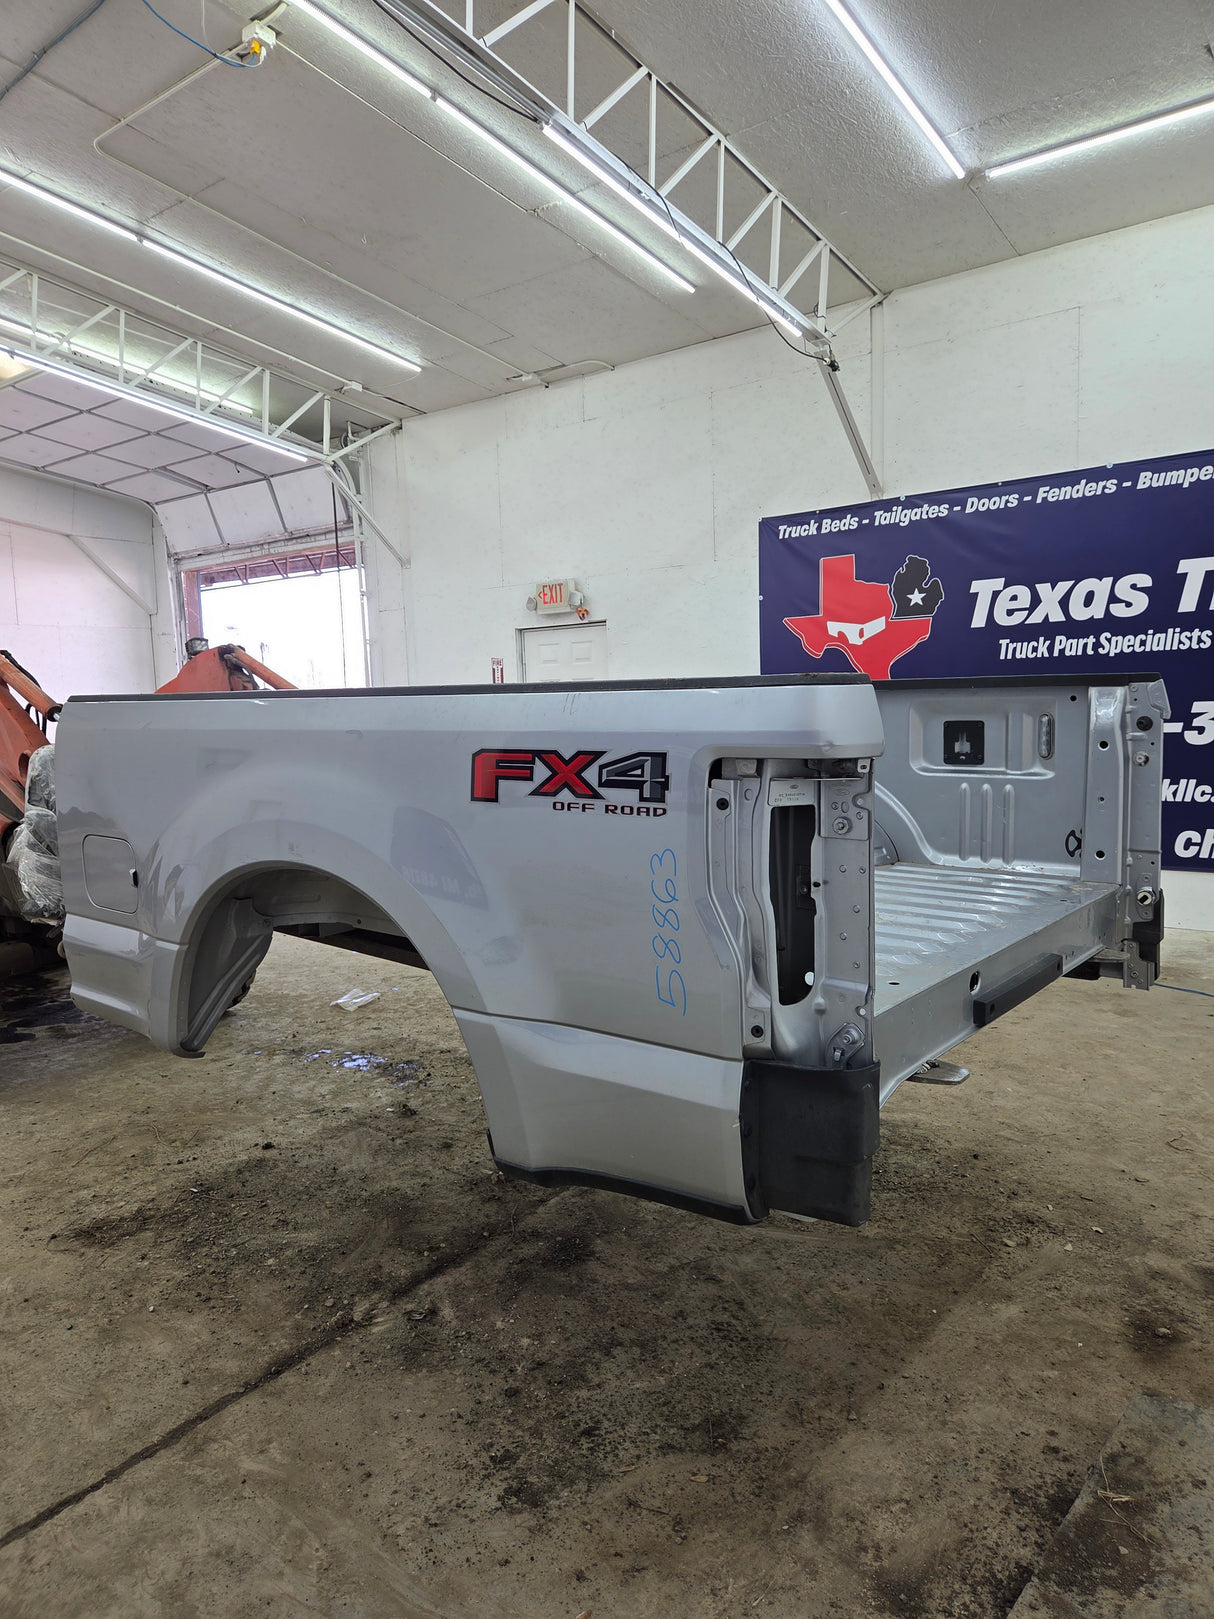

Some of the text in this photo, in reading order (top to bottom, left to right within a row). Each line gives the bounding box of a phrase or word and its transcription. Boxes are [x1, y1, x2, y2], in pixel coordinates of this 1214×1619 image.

[778, 519, 819, 540] Truck
[820, 513, 859, 534] Beds
[874, 503, 950, 527] Tailgates
[965, 493, 1019, 514] Doors
[1036, 478, 1118, 504] Fenders
[1136, 464, 1214, 490] Bumpe
[542, 582, 564, 605] EXIT
[969, 556, 1214, 629] Texas T
[998, 627, 1213, 660] Truck Part Specialists
[470, 748, 670, 803] FX4
[552, 801, 668, 818] OFF ROAD
[650, 848, 687, 1016] 58863
